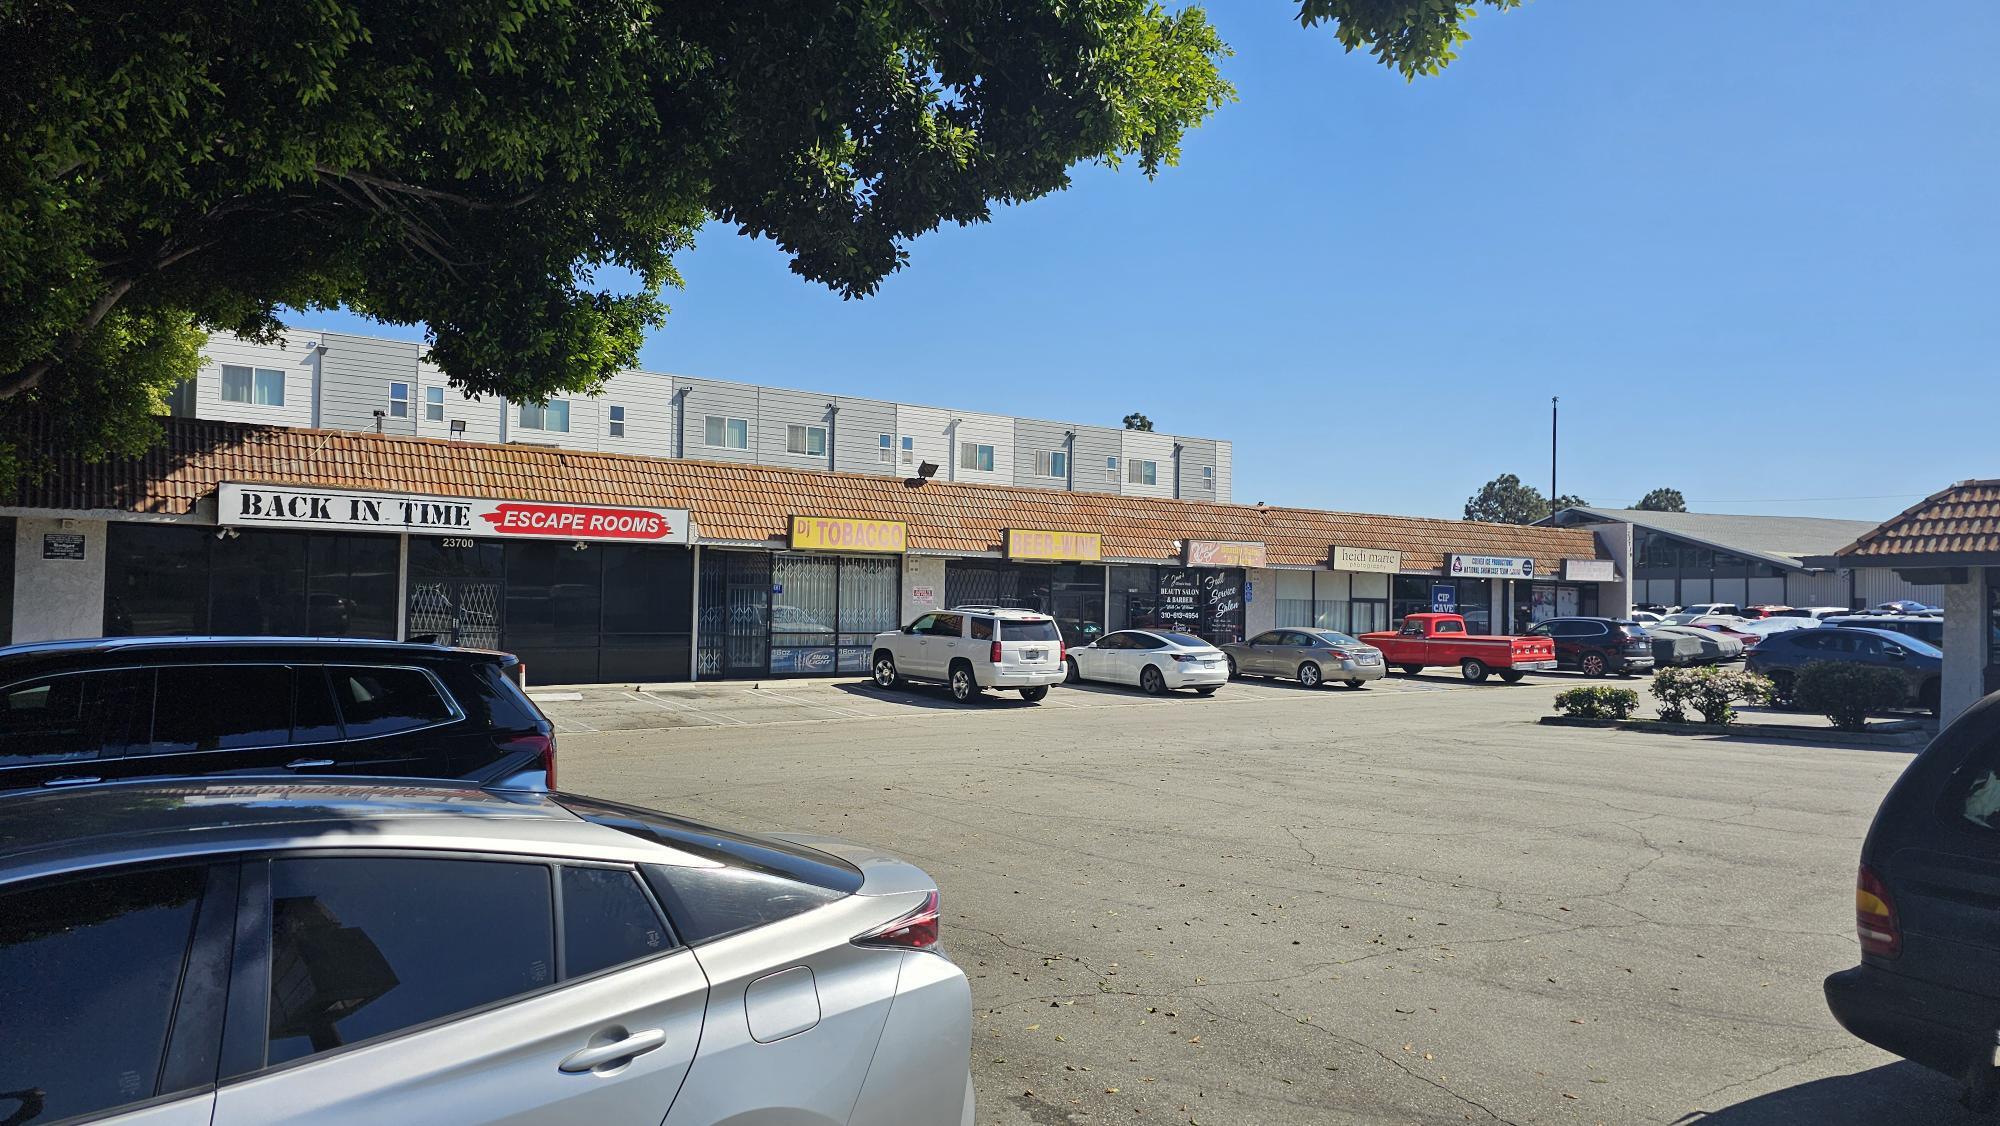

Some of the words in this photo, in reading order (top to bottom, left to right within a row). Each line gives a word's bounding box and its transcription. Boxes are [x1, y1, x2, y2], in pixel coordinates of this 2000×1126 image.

[240, 493, 332, 519] BACK
[349, 499, 382, 521] IN
[399, 501, 471, 527] TIME
[503, 511, 585, 530] ESCAPE
[589, 514, 660, 533] ROOMS
[797, 520, 811, 538] Dj
[816, 520, 903, 547] TOBACCO
[442, 538, 474, 548] 23700
[1342, 549, 1366, 562] heidi
[1368, 552, 1395, 564] marie
[1350, 562, 1386, 570] photography
[1204, 571, 1225, 590] Full
[1209, 586, 1237, 605] Service
[1437, 593, 1450, 602] CIP
[1215, 600, 1239, 618] Salon
[1433, 604, 1454, 612] CAVE
